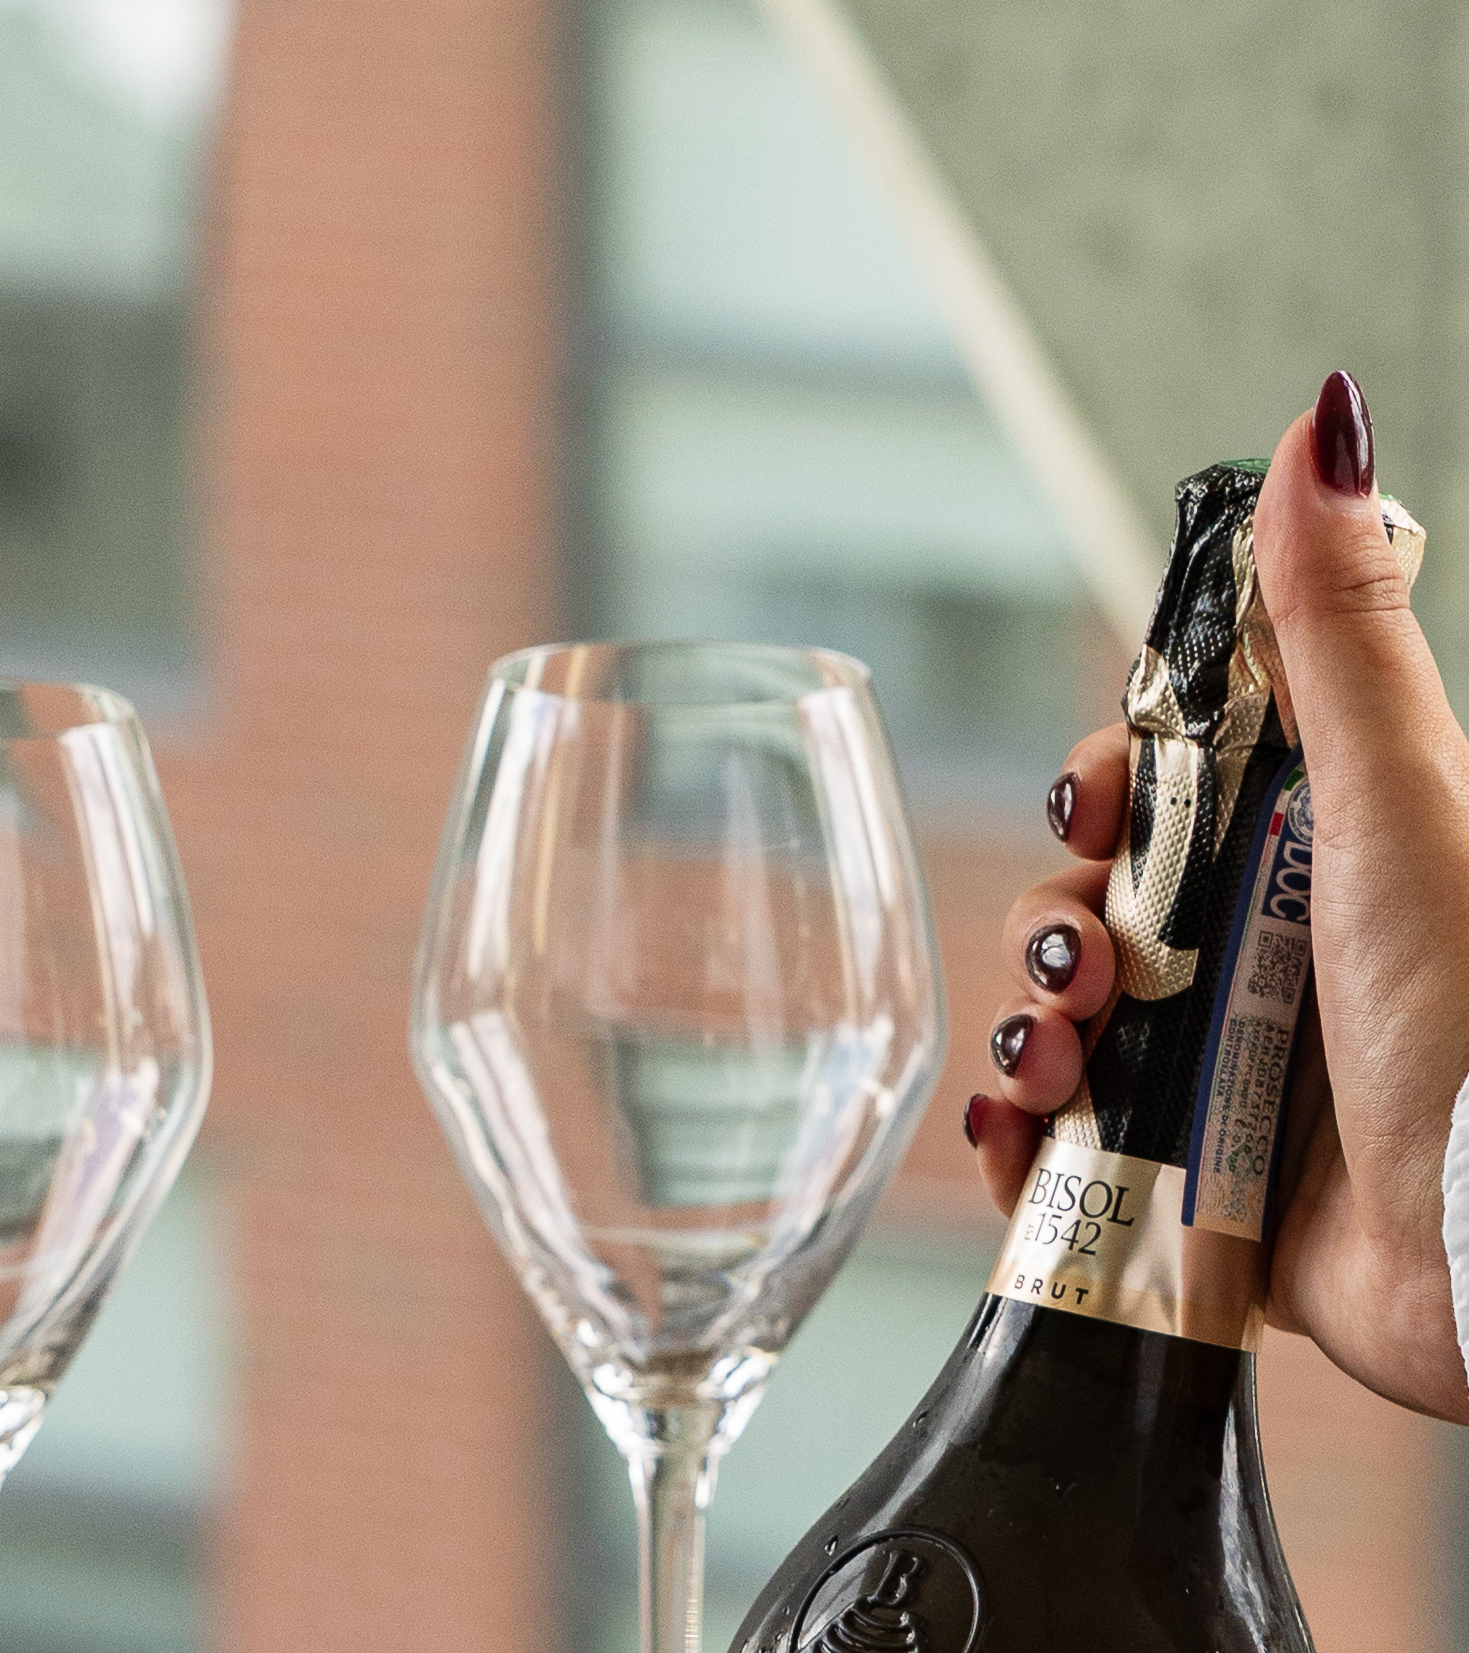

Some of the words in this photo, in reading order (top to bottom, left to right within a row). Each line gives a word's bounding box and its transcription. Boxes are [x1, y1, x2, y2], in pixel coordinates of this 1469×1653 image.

[1269, 840, 1313, 922] DOC
[1216, 1018, 1238, 1097] CONTROLLATA
[1225, 1021, 1246, 1114] DENOMINAZIONE
[1254, 1029, 1290, 1176] PROSECCO
[1213, 1125, 1228, 1174] ORIGINE
[1028, 1168, 1135, 1226] BISOL
[1034, 1212, 1102, 1255] 1542
[1014, 1274, 1089, 1305] BRUT
